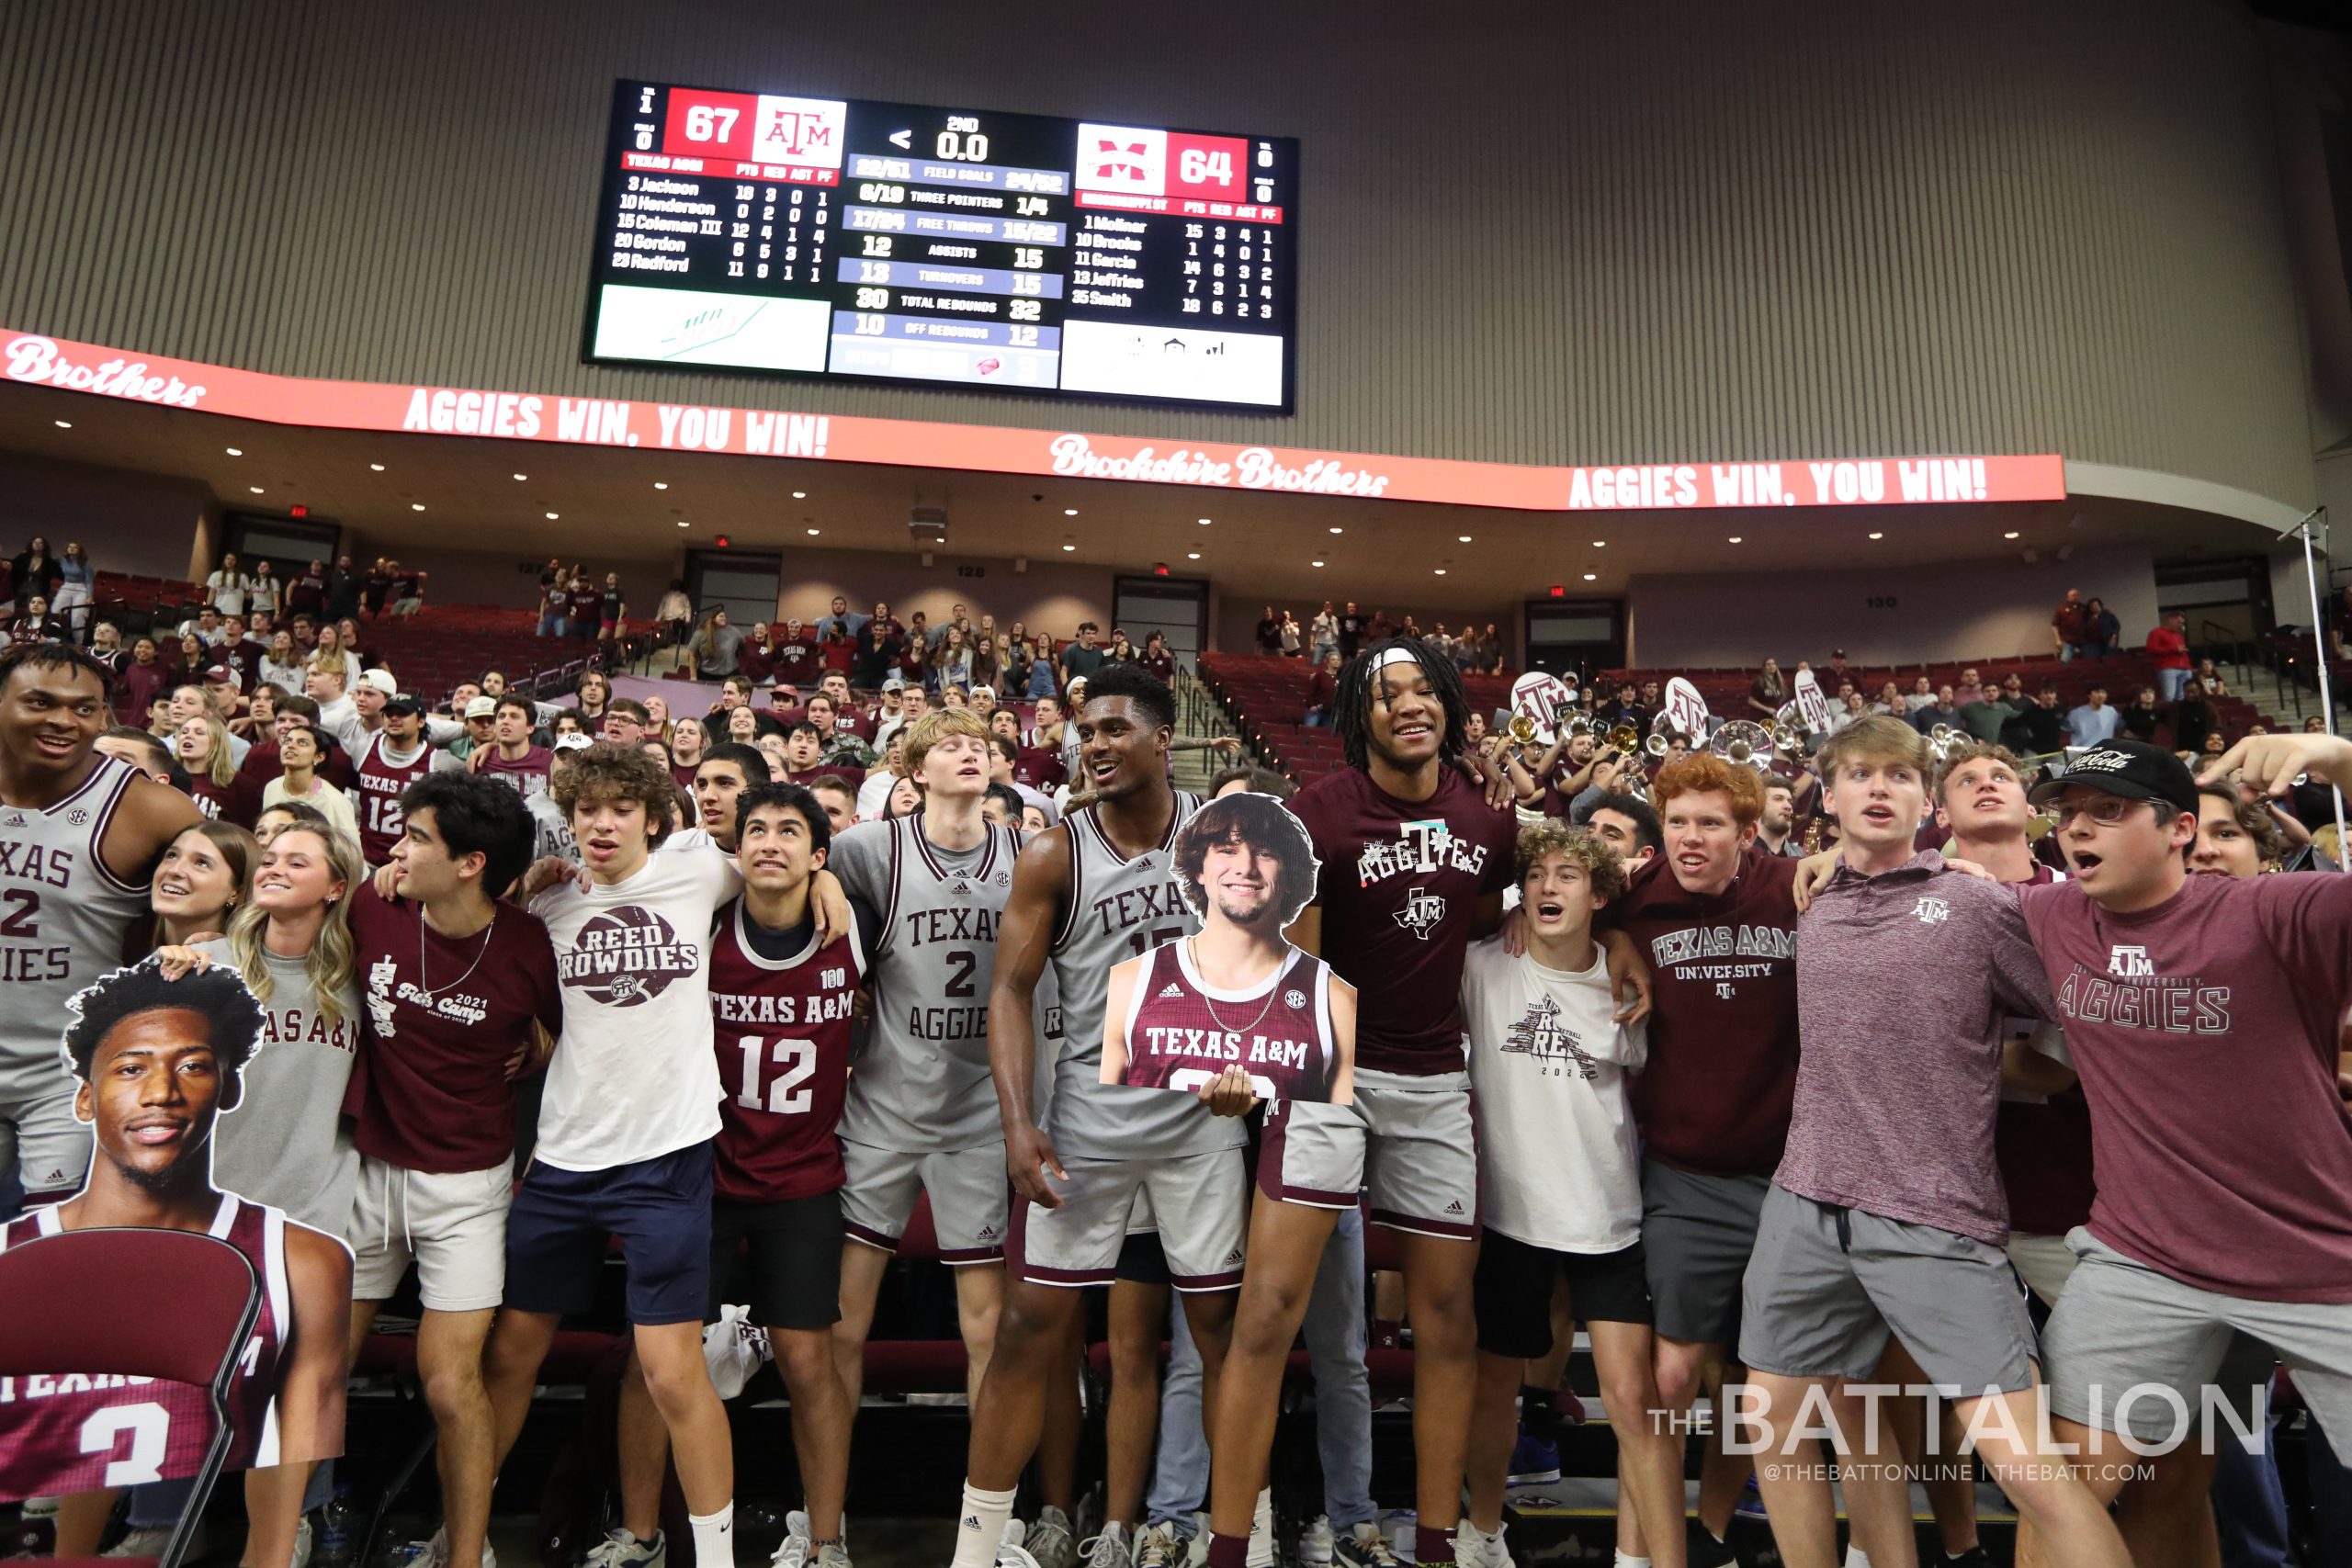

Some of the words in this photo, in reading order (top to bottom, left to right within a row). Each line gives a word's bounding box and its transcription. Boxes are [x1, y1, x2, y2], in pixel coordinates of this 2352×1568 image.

[639, 95, 651, 113] 1
[685, 106, 740, 143] 67
[947, 116, 979, 133] 2ND
[636, 131, 652, 150] 0
[936, 131, 989, 162] 0.0
[628, 154, 671, 169] TEXAS
[736, 164, 759, 177] PTS
[763, 165, 786, 180] REB
[790, 168, 813, 181] AST
[818, 170, 833, 183] PF
[1180, 148, 1233, 186] 64
[1258, 150, 1273, 168] 0
[639, 177, 699, 196] Jackson
[765, 187, 776, 202] 3
[791, 190, 803, 204] 0
[819, 192, 827, 206] 1
[910, 190, 946, 205] THREE
[947, 193, 1003, 209] POINTERS
[1257, 186, 1272, 203] 0
[619, 194, 638, 209] 10
[638, 195, 716, 216] Henderson
[737, 204, 749, 219] 0
[763, 206, 775, 220] 2
[789, 208, 801, 222] 0
[815, 210, 827, 224] 0
[1184, 201, 1206, 215] PTS
[1235, 206, 1258, 219] AST
[1261, 208, 1276, 220] PF
[617, 213, 636, 228] 15
[636, 214, 698, 233] Coleman
[699, 220, 722, 235] III
[731, 223, 749, 238] 12
[761, 225, 772, 240] 4
[788, 227, 797, 242] 1
[813, 230, 824, 243] 4
[916, 218, 946, 231] FREE
[1084, 215, 1093, 230] 1
[1185, 223, 1204, 238] 15
[1215, 226, 1227, 241] 3
[1239, 228, 1250, 243] 4
[1262, 230, 1272, 244] 1
[614, 232, 632, 248] 20
[633, 233, 686, 253] Gordon
[759, 244, 771, 259] 5
[786, 246, 797, 261] 3
[812, 248, 821, 263] 1
[862, 235, 893, 257] 12
[928, 244, 978, 259] ASSISTS
[1013, 248, 1043, 269] 15
[1075, 232, 1092, 247] 10
[1189, 242, 1198, 256] 1
[1214, 244, 1225, 258] 4
[1239, 246, 1250, 260] 0
[1262, 248, 1272, 262] 1
[612, 253, 631, 267] 23
[630, 253, 689, 273] Radford
[728, 261, 744, 276] 11
[784, 265, 793, 280] 1
[810, 267, 820, 282] 1
[1075, 251, 1091, 266] 11
[1238, 265, 1250, 279] 3
[1261, 266, 1272, 281] 2
[918, 270, 984, 286] TURNOVERS
[1012, 274, 1042, 295] 15
[1073, 270, 1091, 286] 13
[1090, 271, 1145, 289] Jeffries
[1186, 279, 1197, 293] 7
[1213, 281, 1225, 296] 3
[1238, 283, 1249, 298] 1
[1260, 286, 1272, 299] 4
[900, 295, 934, 309] TOTAL
[937, 298, 997, 313] REBOUNDS
[1010, 299, 1042, 321] 32
[1071, 289, 1090, 304] 35
[1089, 290, 1132, 308] Smith
[1238, 302, 1249, 317] 2
[1260, 304, 1272, 319] 3
[855, 313, 886, 335] 10
[928, 323, 989, 339] REBOUNDS
[1009, 325, 1038, 347] 12
[6, 336, 207, 407] Brothers
[402, 389, 543, 437] AGGIES
[557, 398, 639, 448] WIN,
[658, 406, 731, 451] YOU
[744, 412, 830, 457] WIN!
[1050, 433, 1233, 486] Brookshire
[1235, 446, 1389, 498] Brothers
[1569, 467, 1699, 510] AGGIES
[1710, 464, 1796, 507] WIN,
[1808, 461, 1885, 503] YOU
[1898, 459, 1987, 502] WIN!
[956, 566, 985, 578] 128
[1867, 596, 1897, 608] 130
[360, 773, 398, 794] TEXAS
[368, 796, 404, 835] 12
[585, 925, 663, 952] REED
[1651, 926, 1734, 968] TEXAS
[1736, 924, 1798, 961] A&M
[560, 945, 698, 980] ROWDIES
[944, 951, 977, 998] 2
[1675, 963, 1772, 980] UNIVERSITY
[437, 998, 486, 1027] Camp
[455, 993, 488, 1009] 2021
[708, 990, 796, 1023] TEXAS
[805, 990, 854, 1023] A&M
[2057, 973, 2231, 1036] AGGIES
[1146, 1027, 1241, 1061] TEXAS
[1249, 1035, 1308, 1071] A&M
[738, 1035, 817, 1114] 12
